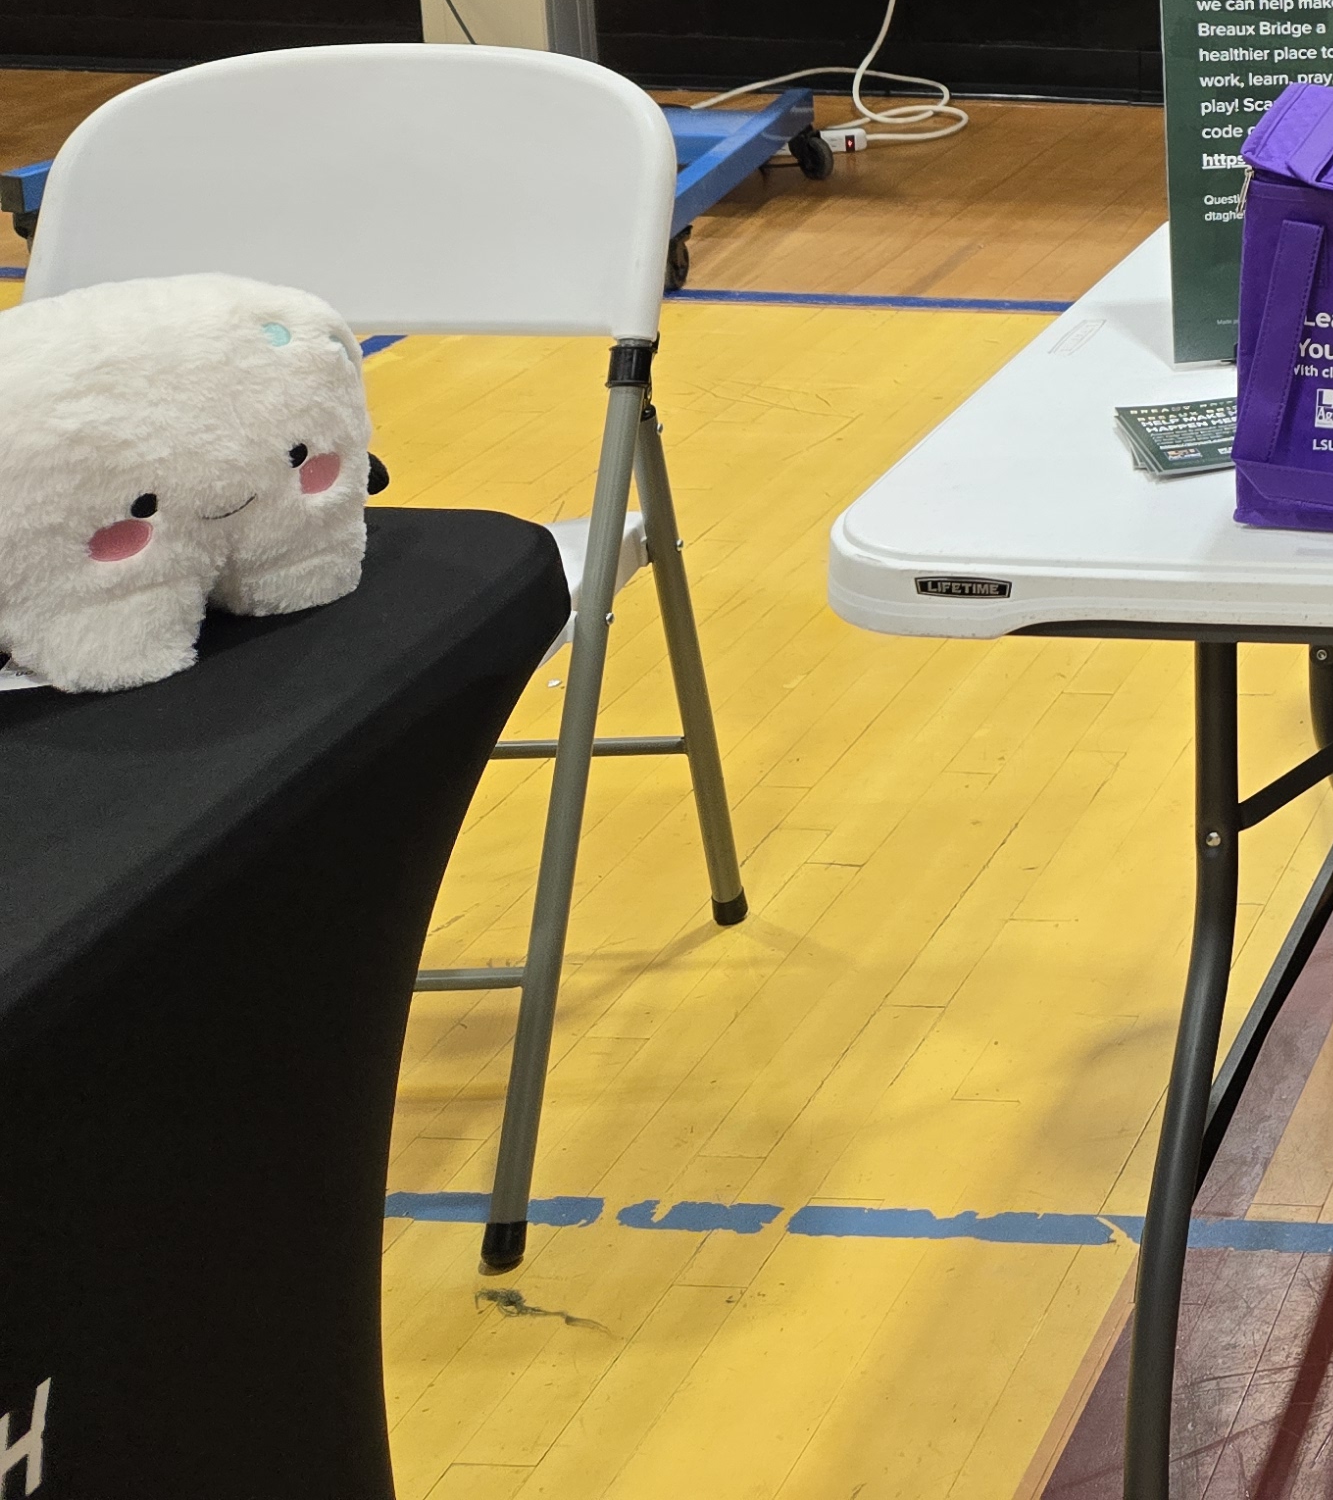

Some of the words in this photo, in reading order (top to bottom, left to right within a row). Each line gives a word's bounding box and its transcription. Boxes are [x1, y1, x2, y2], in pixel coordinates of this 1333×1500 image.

[1197, 0, 1222, 12] we
[1226, 0, 1255, 11] can
[1198, 22, 1255, 37] Breaux
[1260, 21, 1313, 39] Bridge
[1316, 23, 1327, 34] a
[1199, 47, 1270, 62] healthier
[1274, 46, 1318, 66] place
[1199, 73, 1245, 89] work,
[1248, 72, 1294, 87] learn,
[1201, 98, 1239, 117] play!
[1202, 125, 1245, 139] code
[927, 581, 999, 595] LIFETIME
